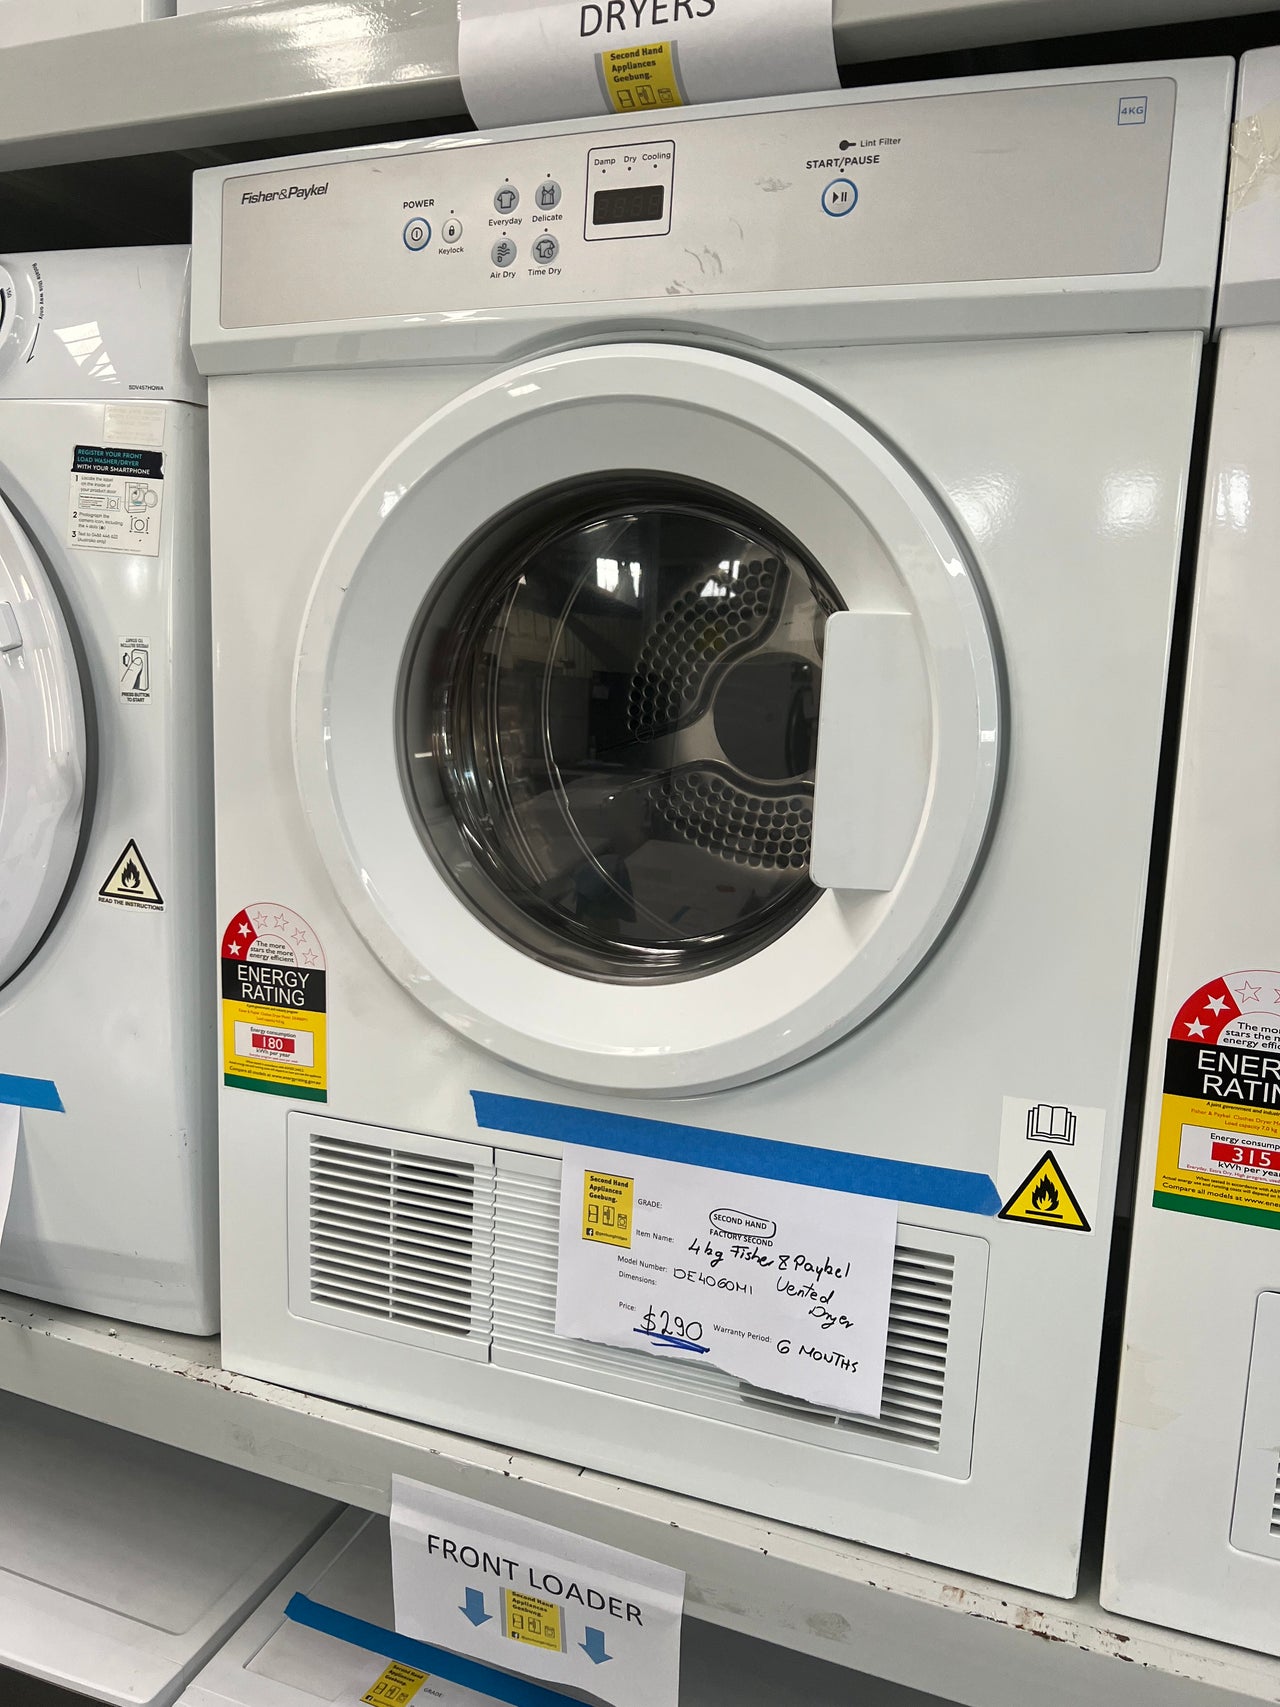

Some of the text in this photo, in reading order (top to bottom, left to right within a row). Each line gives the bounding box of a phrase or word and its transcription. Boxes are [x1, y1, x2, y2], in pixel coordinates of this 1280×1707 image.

[580, 0, 716, 37] DRYERS
[610, 45, 664, 61] Second Hand
[611, 60, 657, 74] Appliances
[613, 72, 653, 83] Geebung.
[1121, 106, 1144, 115] 4KG
[860, 138, 901, 147] Lint Filter
[594, 151, 671, 166] Damp Dry Cooling
[805, 154, 881, 169] START/PAUSE
[241, 182, 329, 205] Fisher&Paykel
[402, 198, 435, 209] POWER
[488, 216, 523, 227] Everyday
[532, 213, 563, 223] Delicate
[438, 245, 464, 255] Keylock
[489, 270, 517, 279] Air Dry
[527, 266, 562, 276] Time Dry
[94, 458, 139, 466] WASHER/DRYER
[110, 466, 151, 475] SMARTPHONE
[71, 530, 77, 538] 3
[125, 901, 164, 911] INSTRUCTIONS
[256, 940, 268, 948] The
[249, 952, 294, 963] energy efficient
[265, 947, 276, 955] the
[276, 949, 293, 957] more
[237, 964, 310, 989] ENERGY
[242, 982, 305, 1006] RATING
[250, 1026, 266, 1034] Energy
[1237, 1021, 1258, 1031] The
[1223, 1036, 1259, 1048] energy
[1225, 1029, 1251, 1039] stars
[1253, 1033, 1271, 1042] the
[262, 1036, 284, 1050] 180
[1210, 1132, 1239, 1144] Energy
[1231, 1147, 1272, 1167] 315
[1218, 1161, 1242, 1171] kWh
[1243, 1165, 1261, 1175] per
[590, 1175, 629, 1188] Second Hand
[589, 1183, 623, 1195] Appliances
[1162, 1181, 1196, 1193] Compare
[1197, 1187, 1206, 1195] all
[1206, 1190, 1233, 1200] models
[637, 1198, 663, 1209] GRADE:
[713, 1213, 767, 1230] SECOND HAND
[636, 1229, 651, 1239] Item
[652, 1232, 675, 1244] Name:
[709, 1228, 774, 1248] FACTORY SECOND
[730, 1245, 774, 1268] Fisher
[617, 1255, 668, 1273] Model Number:
[618, 1270, 657, 1286] Dimensions:
[776, 1276, 835, 1305] Vented
[618, 1301, 637, 1312] Price:
[640, 1304, 703, 1341] $290
[808, 1306, 854, 1330] Dryer
[713, 1323, 773, 1344] Warranty Period:
[776, 1339, 792, 1354] 6
[427, 1534, 644, 1627] FRONT LOADER
[511, 1591, 554, 1609] Second Hand
[511, 1597, 548, 1613] Appliances
